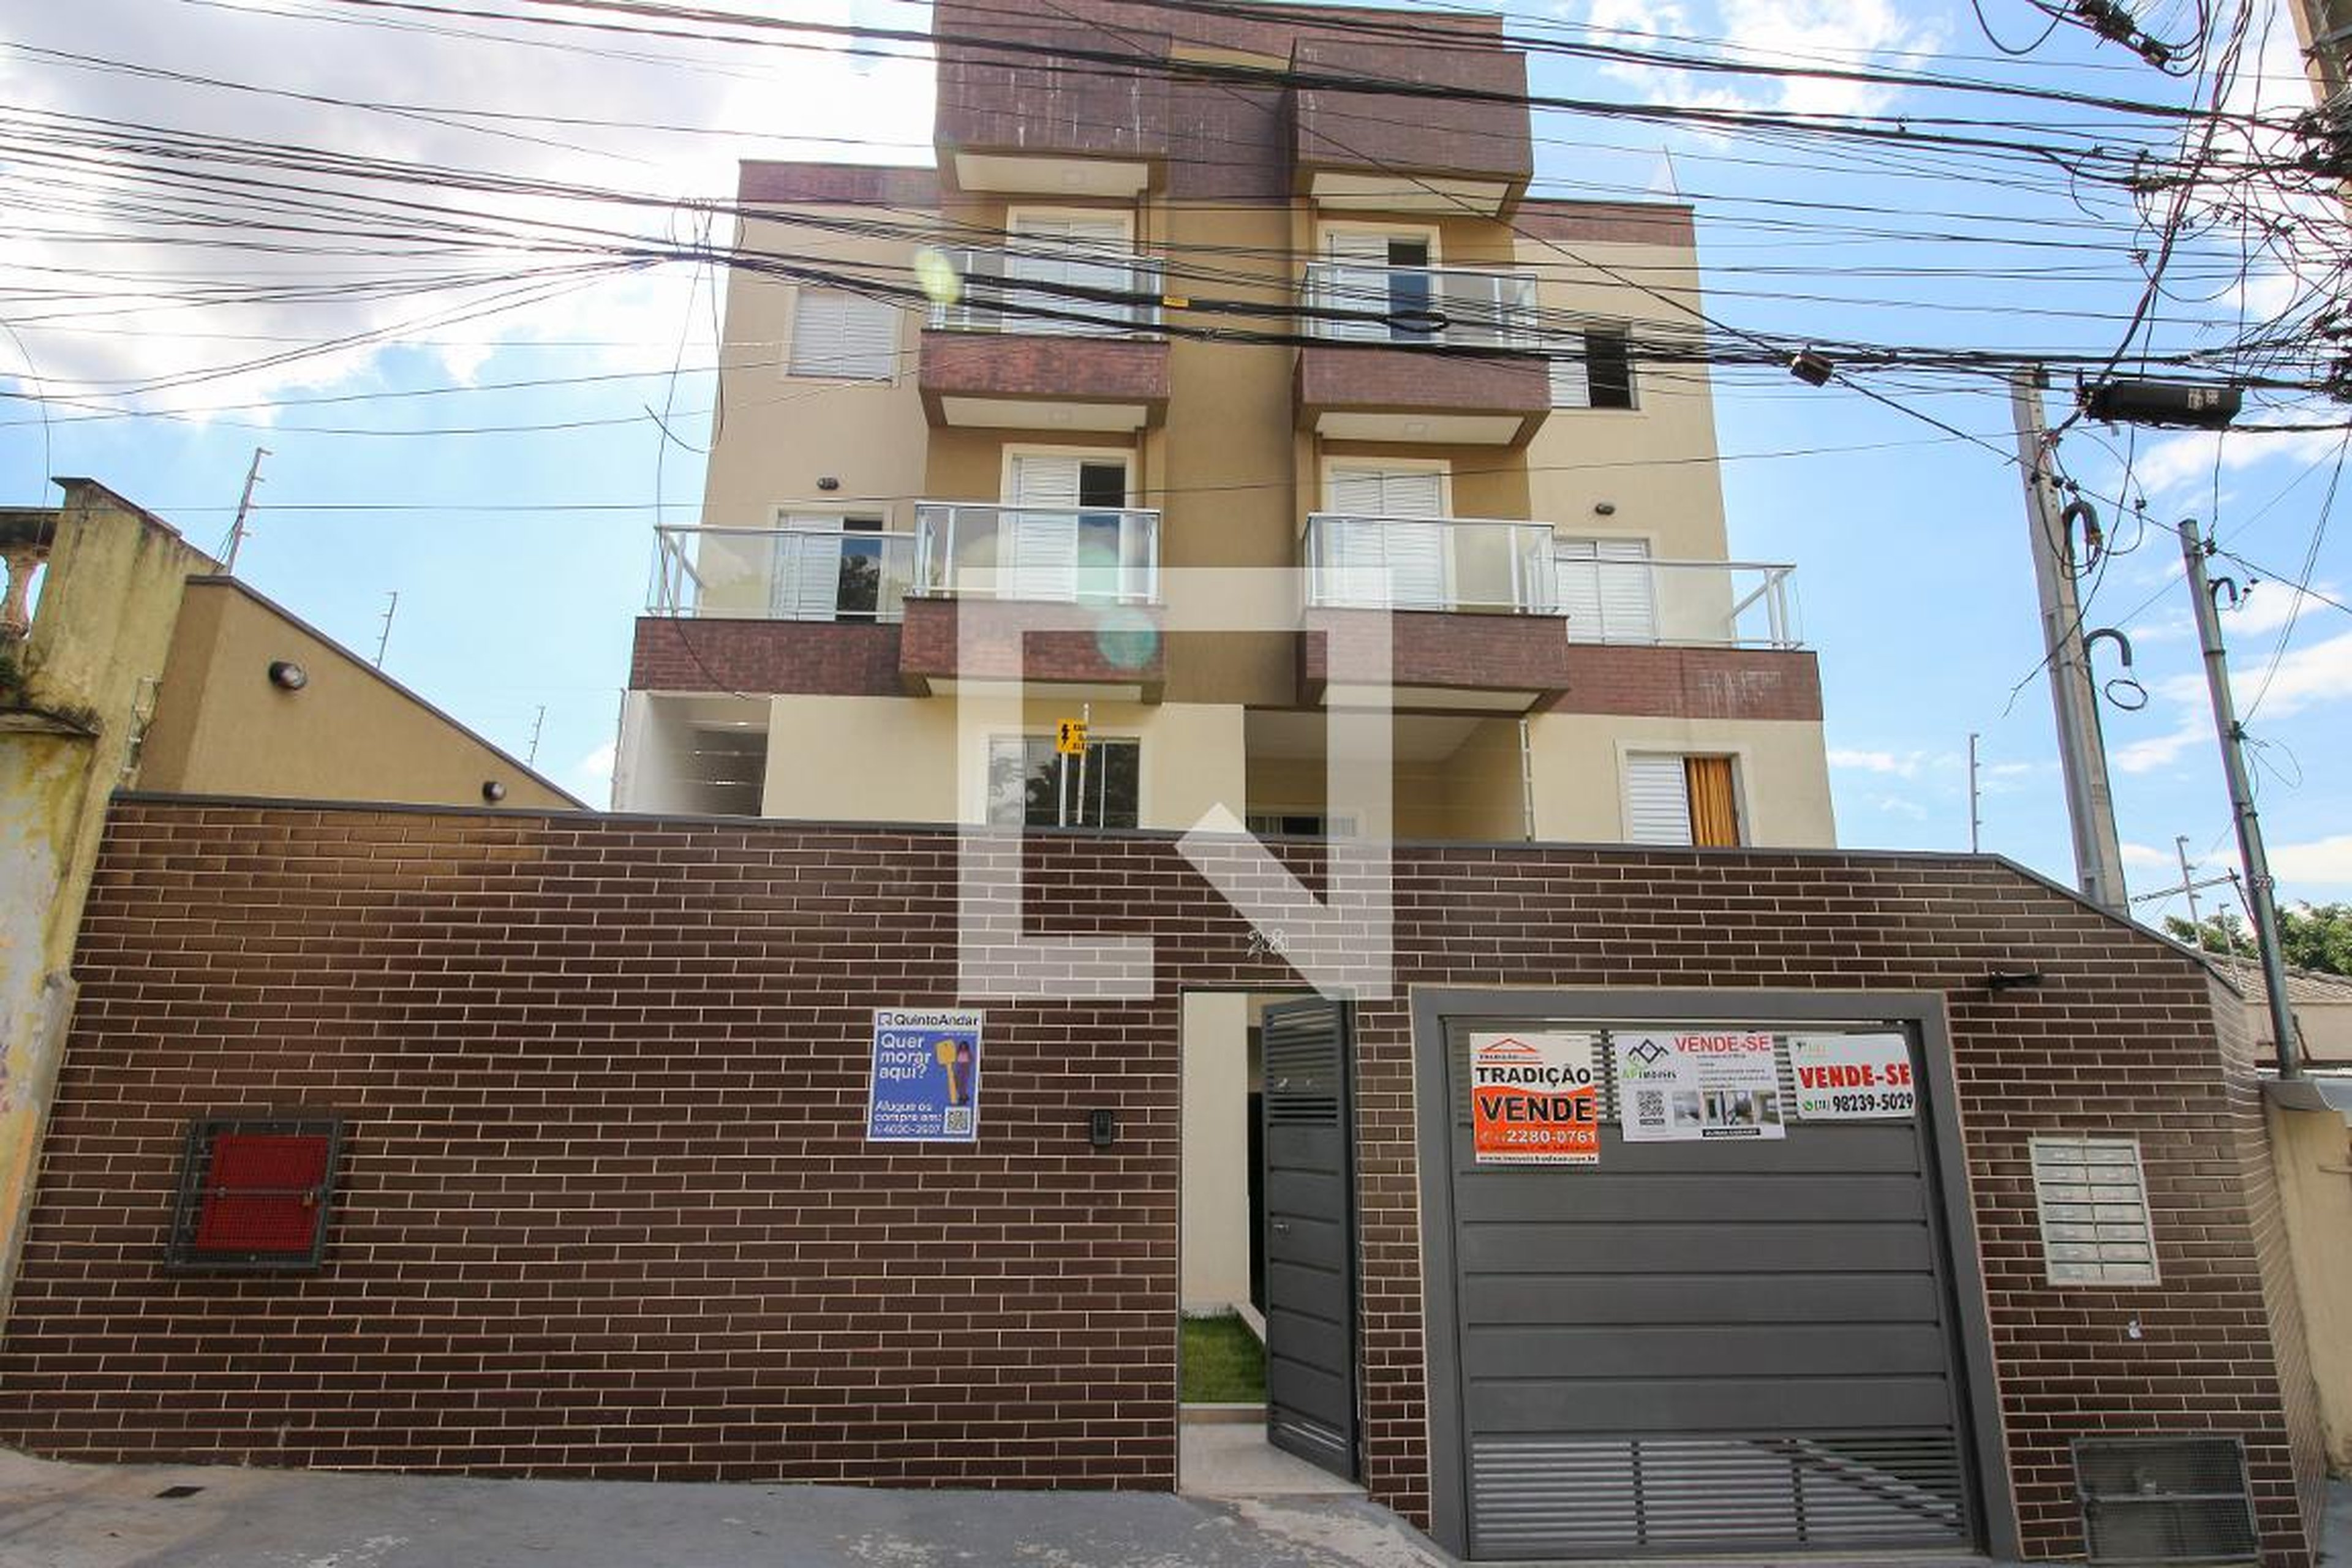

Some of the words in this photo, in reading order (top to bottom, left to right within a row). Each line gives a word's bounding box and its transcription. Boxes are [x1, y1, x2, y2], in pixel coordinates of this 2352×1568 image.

[894, 1014, 979, 1026] QuintoAndar
[881, 1033, 925, 1049] Quer
[1675, 1036, 1771, 1052] VENDE-SE
[880, 1052, 932, 1064] morar
[879, 1063, 927, 1082] aqui?
[1476, 1063, 1591, 1087] TRADIÇÃO
[1798, 1063, 1911, 1089] VENDE-SE
[1480, 1096, 1593, 1121] VENDE
[1833, 1092, 1914, 1112] 98239-5029
[1506, 1130, 1596, 1144] 2280-0761
